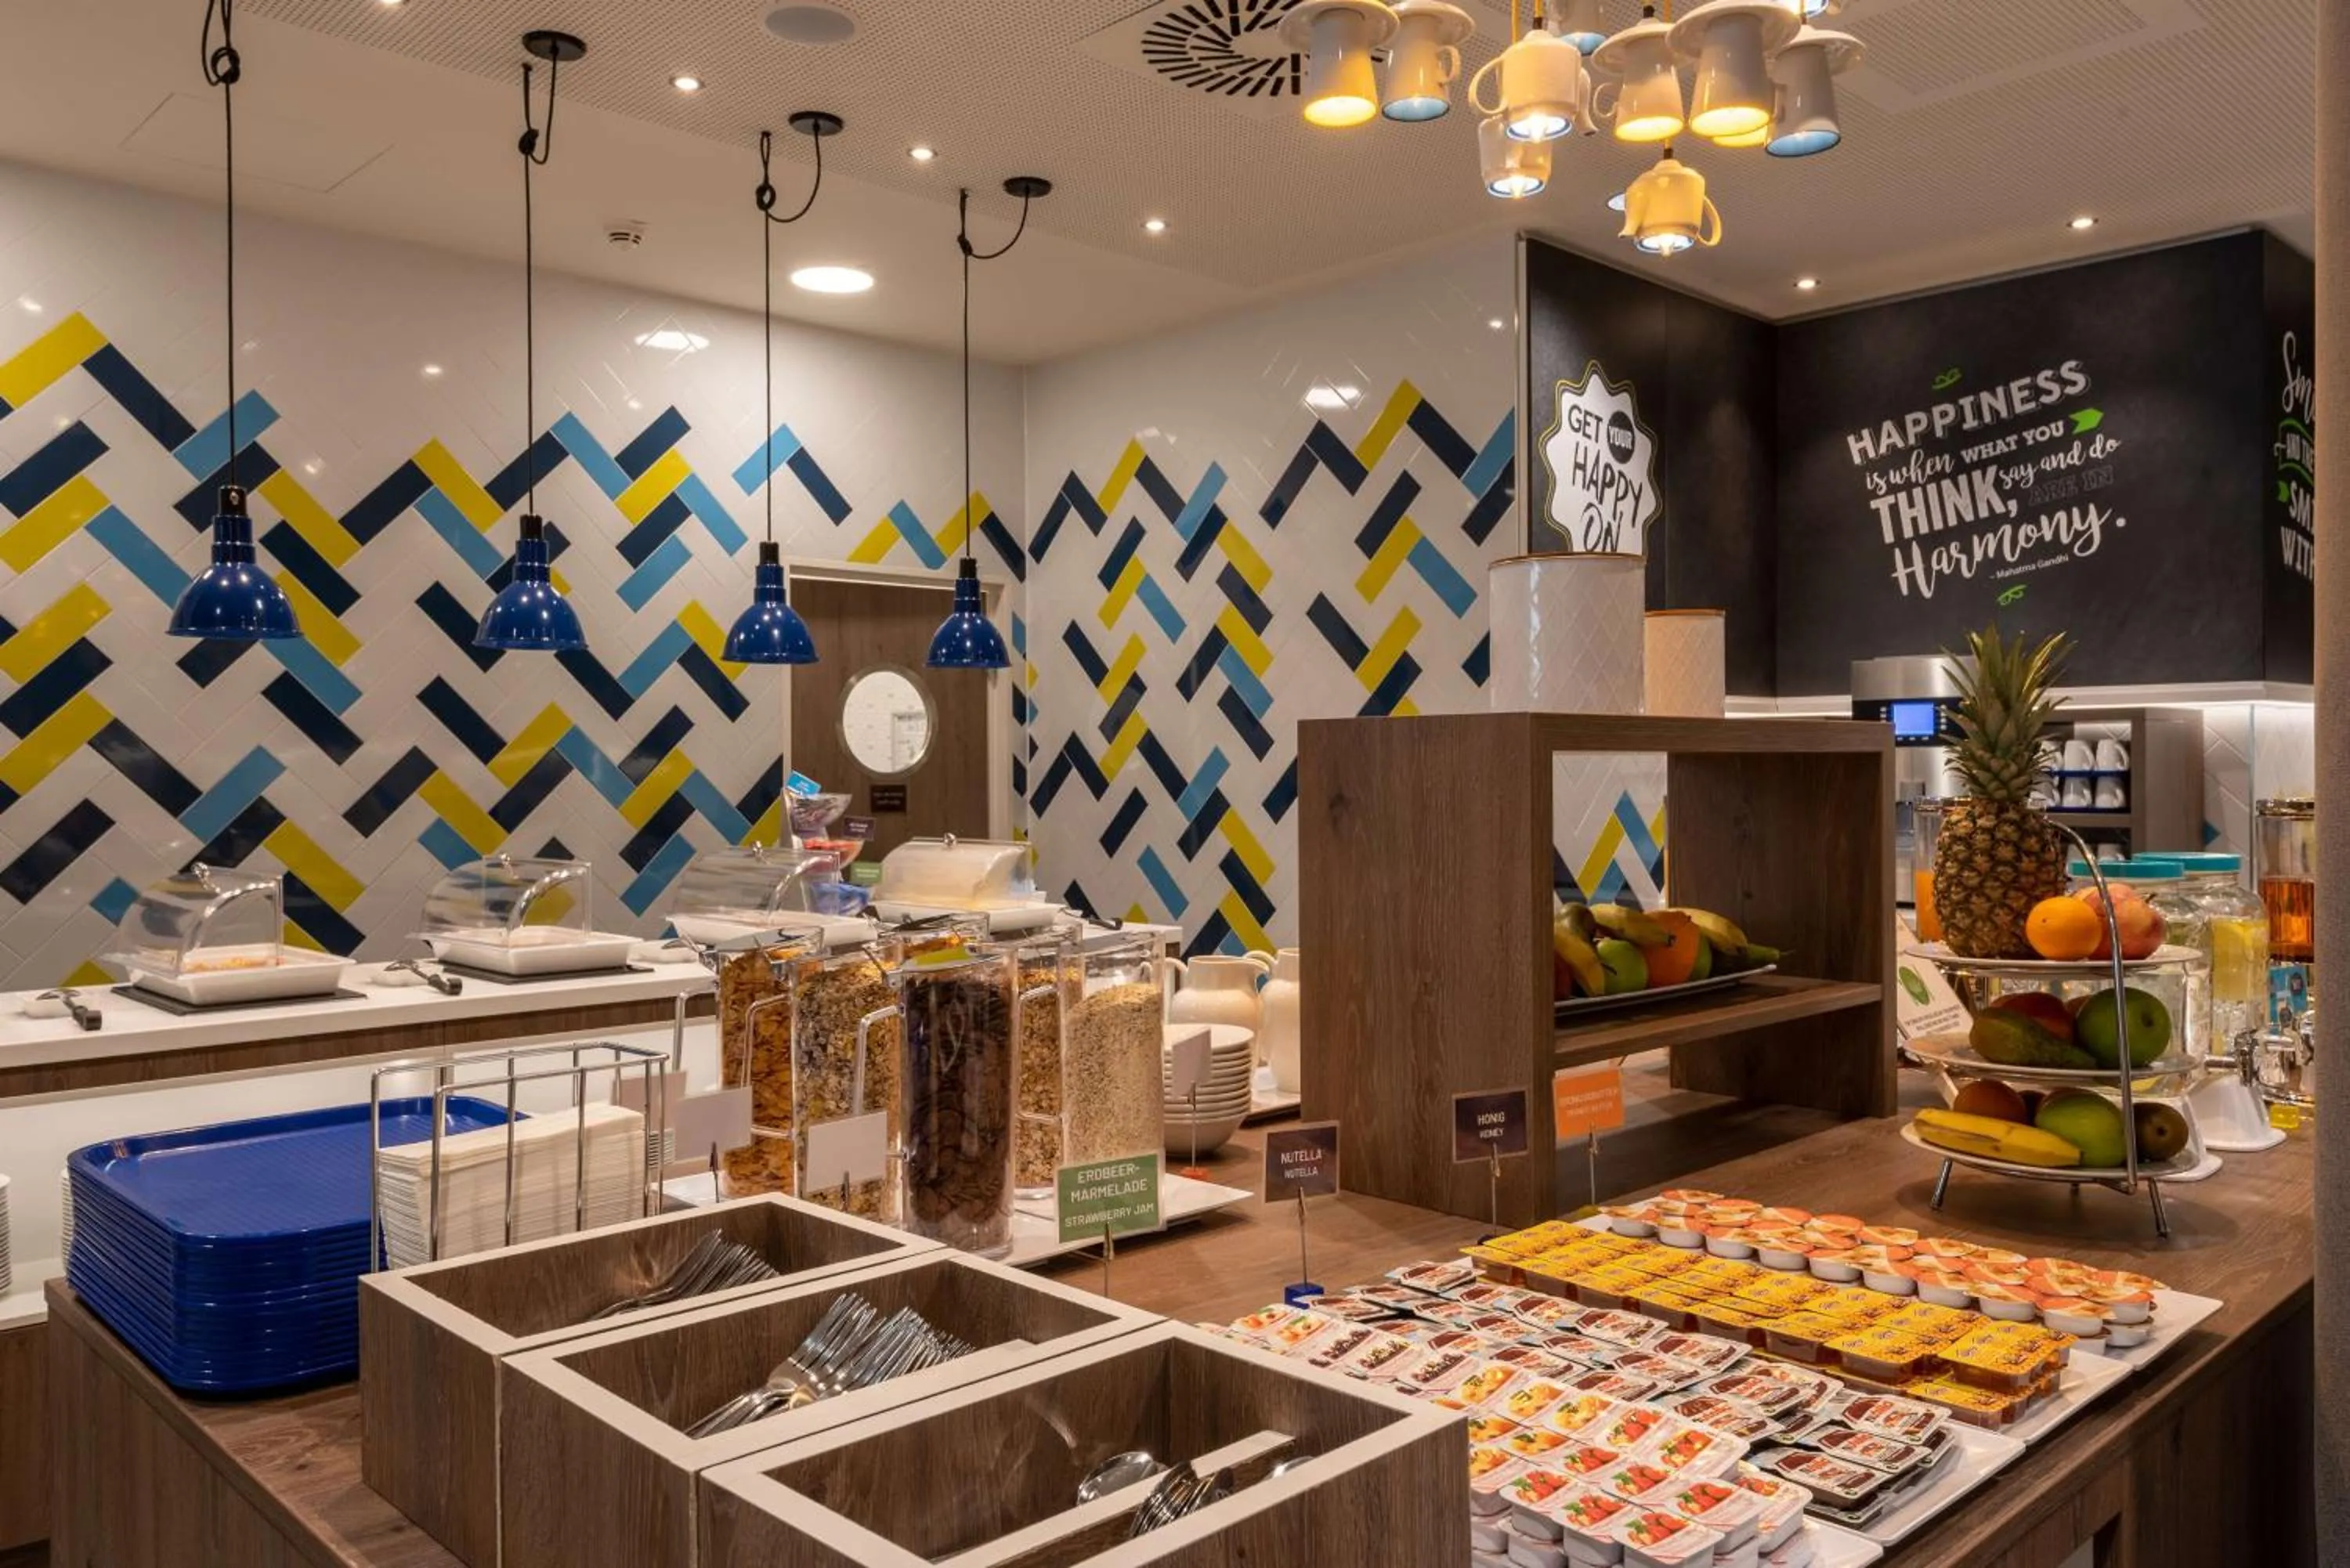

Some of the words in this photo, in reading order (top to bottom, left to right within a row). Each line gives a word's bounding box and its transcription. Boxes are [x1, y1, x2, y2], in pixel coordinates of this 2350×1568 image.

[1567, 404, 1603, 444] GET
[1846, 359, 2090, 466] HAPPINESS
[1866, 471, 1886, 495] is
[1889, 448, 1955, 486] when
[1961, 435, 2019, 464] WHAT
[2022, 419, 2066, 446] YOU
[1571, 441, 1643, 529] HAPPY
[1869, 464, 2019, 545] THINK,
[1998, 462, 2037, 490] say
[2040, 439, 2087, 471] and
[2089, 432, 2122, 460] do
[1580, 501, 1624, 553] ON
[1891, 502, 2127, 600] Harmony.
[1996, 562, 2036, 579] Mahatma
[1477, 1111, 1505, 1126] HONIG
[1281, 1148, 1322, 1165] NUTELLA
[1285, 1165, 1319, 1179] NUTELLA
[1077, 1163, 1141, 1184] ERDBEER-
[1071, 1179, 1148, 1204] MARMELADE
[1065, 1206, 1132, 1228] STRAWBERRY
[1133, 1202, 1155, 1215] JAM
